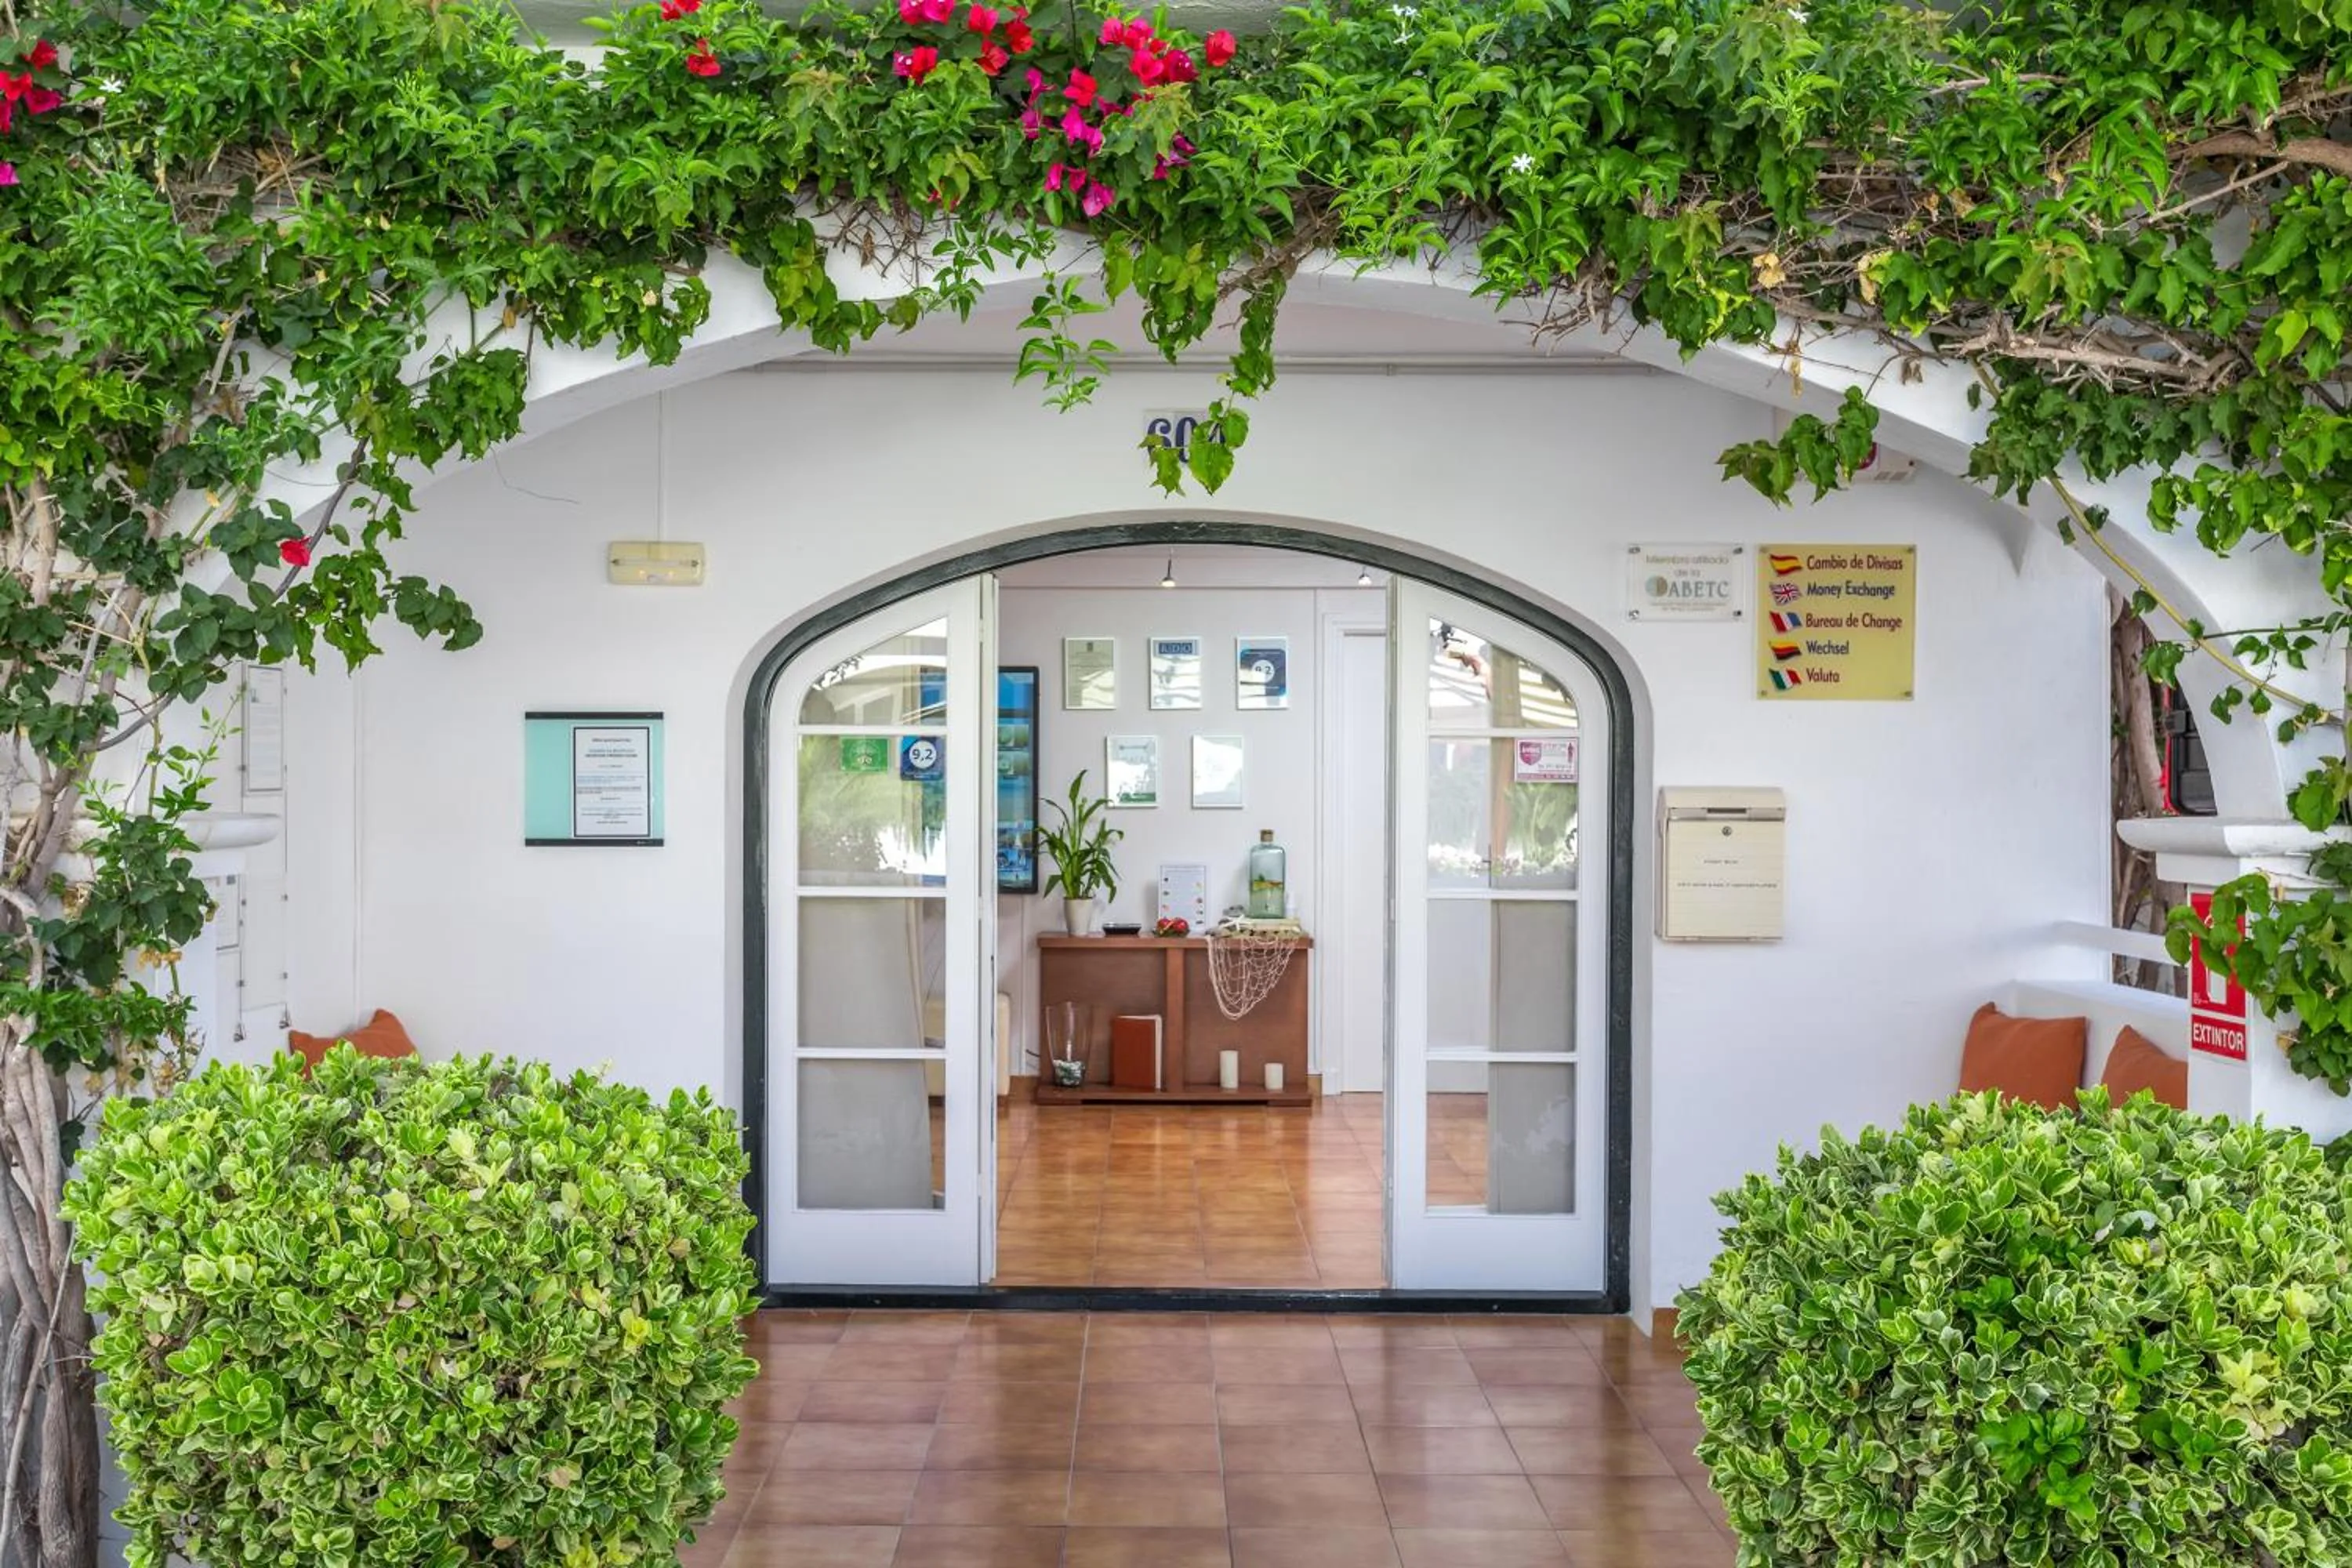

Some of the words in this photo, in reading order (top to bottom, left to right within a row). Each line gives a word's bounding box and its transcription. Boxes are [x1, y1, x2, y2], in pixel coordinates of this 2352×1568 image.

[1806, 554, 1848, 570] Cambio
[1849, 554, 1864, 569] de
[1867, 554, 1903, 570] Divisas
[1668, 580, 1730, 597] ABETC
[1806, 581, 1842, 599] Money
[1845, 580, 1895, 600] Exchange
[1806, 612, 1843, 627] Bureau
[1846, 612, 1859, 627] de
[1862, 612, 1902, 632] Change
[1806, 640, 1849, 654] Wechsel
[1806, 668, 1840, 682] Valuta
[912, 749, 933, 761] 9,2
[2193, 1022, 2244, 1052] EXTINTOR
